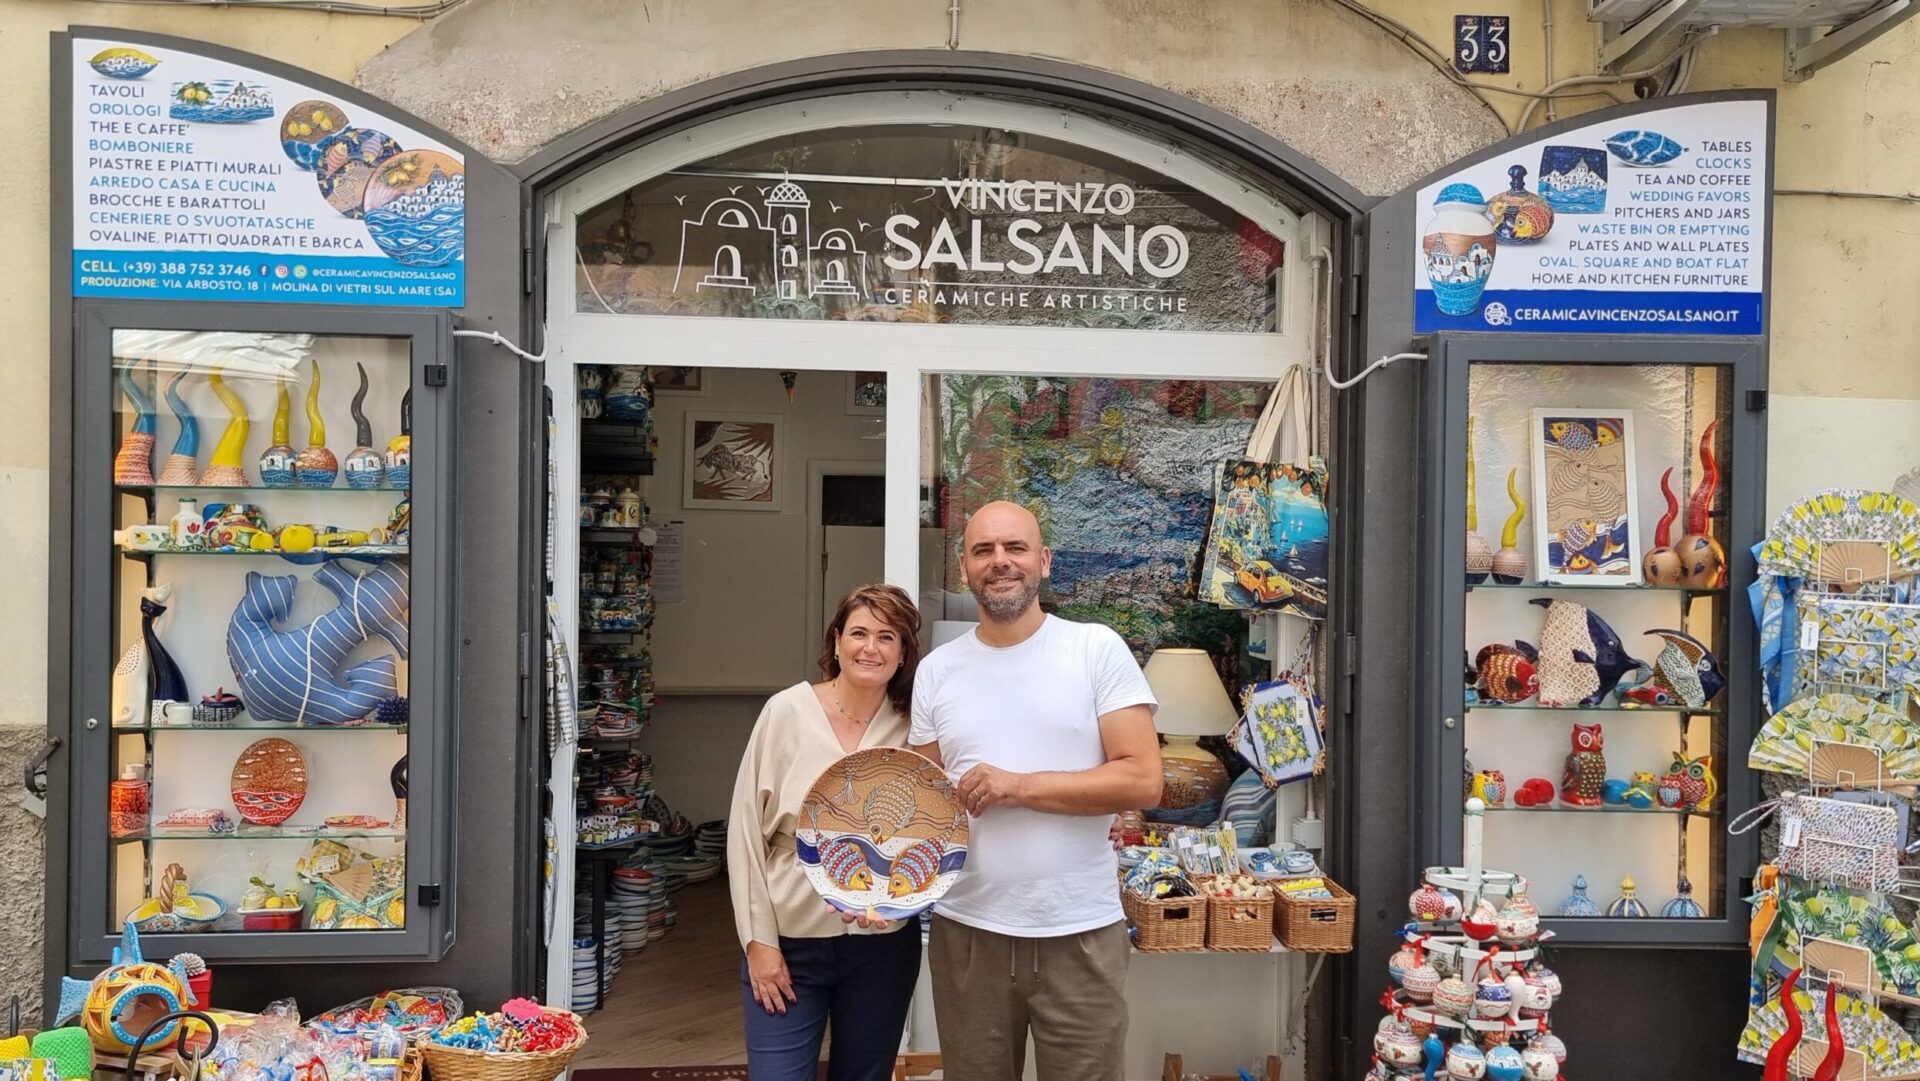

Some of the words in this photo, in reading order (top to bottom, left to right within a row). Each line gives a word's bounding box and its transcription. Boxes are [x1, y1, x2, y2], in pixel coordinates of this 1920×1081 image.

[1461, 25, 1506, 63] 33
[89, 84, 144, 98] TAVOLI
[89, 102, 161, 117] OROLOGI
[89, 121, 119, 133] THE
[124, 122, 133, 134] E
[89, 139, 194, 154] BOMBONIERE
[1701, 141, 1752, 152] TABLES
[89, 157, 153, 171] PIASTRE
[158, 159, 166, 171] E
[171, 160, 218, 172] PIATTI
[222, 162, 281, 175] MURALI
[1695, 158, 1752, 169] CLOCKS
[89, 176, 154, 189] ARREDO
[159, 178, 201, 190] CASA
[205, 179, 213, 191] E
[218, 180, 277, 192] CUCINA
[1636, 174, 1663, 185] TEA
[1666, 174, 1695, 185] AND
[1699, 174, 1751, 186] COFFEE
[89, 193, 162, 207] BROCCHE
[167, 196, 175, 208] E
[180, 196, 265, 210] BARATTOLI
[942, 177, 1135, 216] VINCENZO
[1629, 191, 1693, 202] WEDDING
[1698, 191, 1751, 202] FAVORS
[1614, 207, 1680, 219] PITCHERS
[1684, 208, 1713, 219] AND
[1716, 208, 1750, 219] JARS
[89, 211, 172, 225] CENERIERE
[176, 214, 189, 226] O
[194, 214, 315, 230] SVUOTATASCHE
[1578, 223, 1626, 235] WASTE
[1631, 224, 1652, 235] BIN
[1656, 224, 1676, 235] OR
[1680, 224, 1750, 236] EMPTYING
[89, 229, 160, 244] OVALINE,
[165, 232, 211, 244] PIATTI
[216, 233, 295, 247] QUADRATI
[300, 236, 307, 247] E
[312, 236, 364, 249] BARCA
[883, 213, 1189, 278] SALSANO
[1569, 240, 1619, 252] PLATES
[1623, 241, 1652, 252] AND
[1656, 241, 1695, 252] WALL
[1699, 241, 1750, 253] PLATES
[81, 260, 120, 273] CELL.
[123, 261, 156, 274] (+39)
[159, 262, 186, 275] 388
[190, 263, 214, 275] 752
[218, 263, 251, 276] 3746
[1539, 256, 1579, 268] OVAL,
[1583, 257, 1639, 269] SQUARE
[1643, 257, 1672, 268] AND
[1676, 257, 1712, 269] BOAT
[1716, 257, 1749, 269] FLAT
[312, 268, 456, 281] @CERAMICAVINCENZOSALSANO
[1532, 273, 1573, 284] HOME
[1578, 273, 1607, 285] AND
[1611, 274, 1670, 285] KITCHEN
[1674, 274, 1749, 286] FURNITURE
[81, 276, 159, 288] PRODUZIONE:
[162, 279, 183, 289] VIA
[186, 279, 244, 291] ARBOSTO,
[248, 281, 259, 291] 18
[271, 282, 319, 293] MOLINA
[321, 283, 332, 293] DI
[336, 284, 371, 294] VIETRI
[374, 285, 395, 295] SUL
[399, 286, 431, 296] MARE
[434, 286, 456, 297] (SA)
[884, 288, 1030, 308] CERAMICHE
[1043, 292, 1187, 313] ARTISTICHE
[1514, 308, 1739, 322] CERAMICAVINCENZOSALSANO.IT
